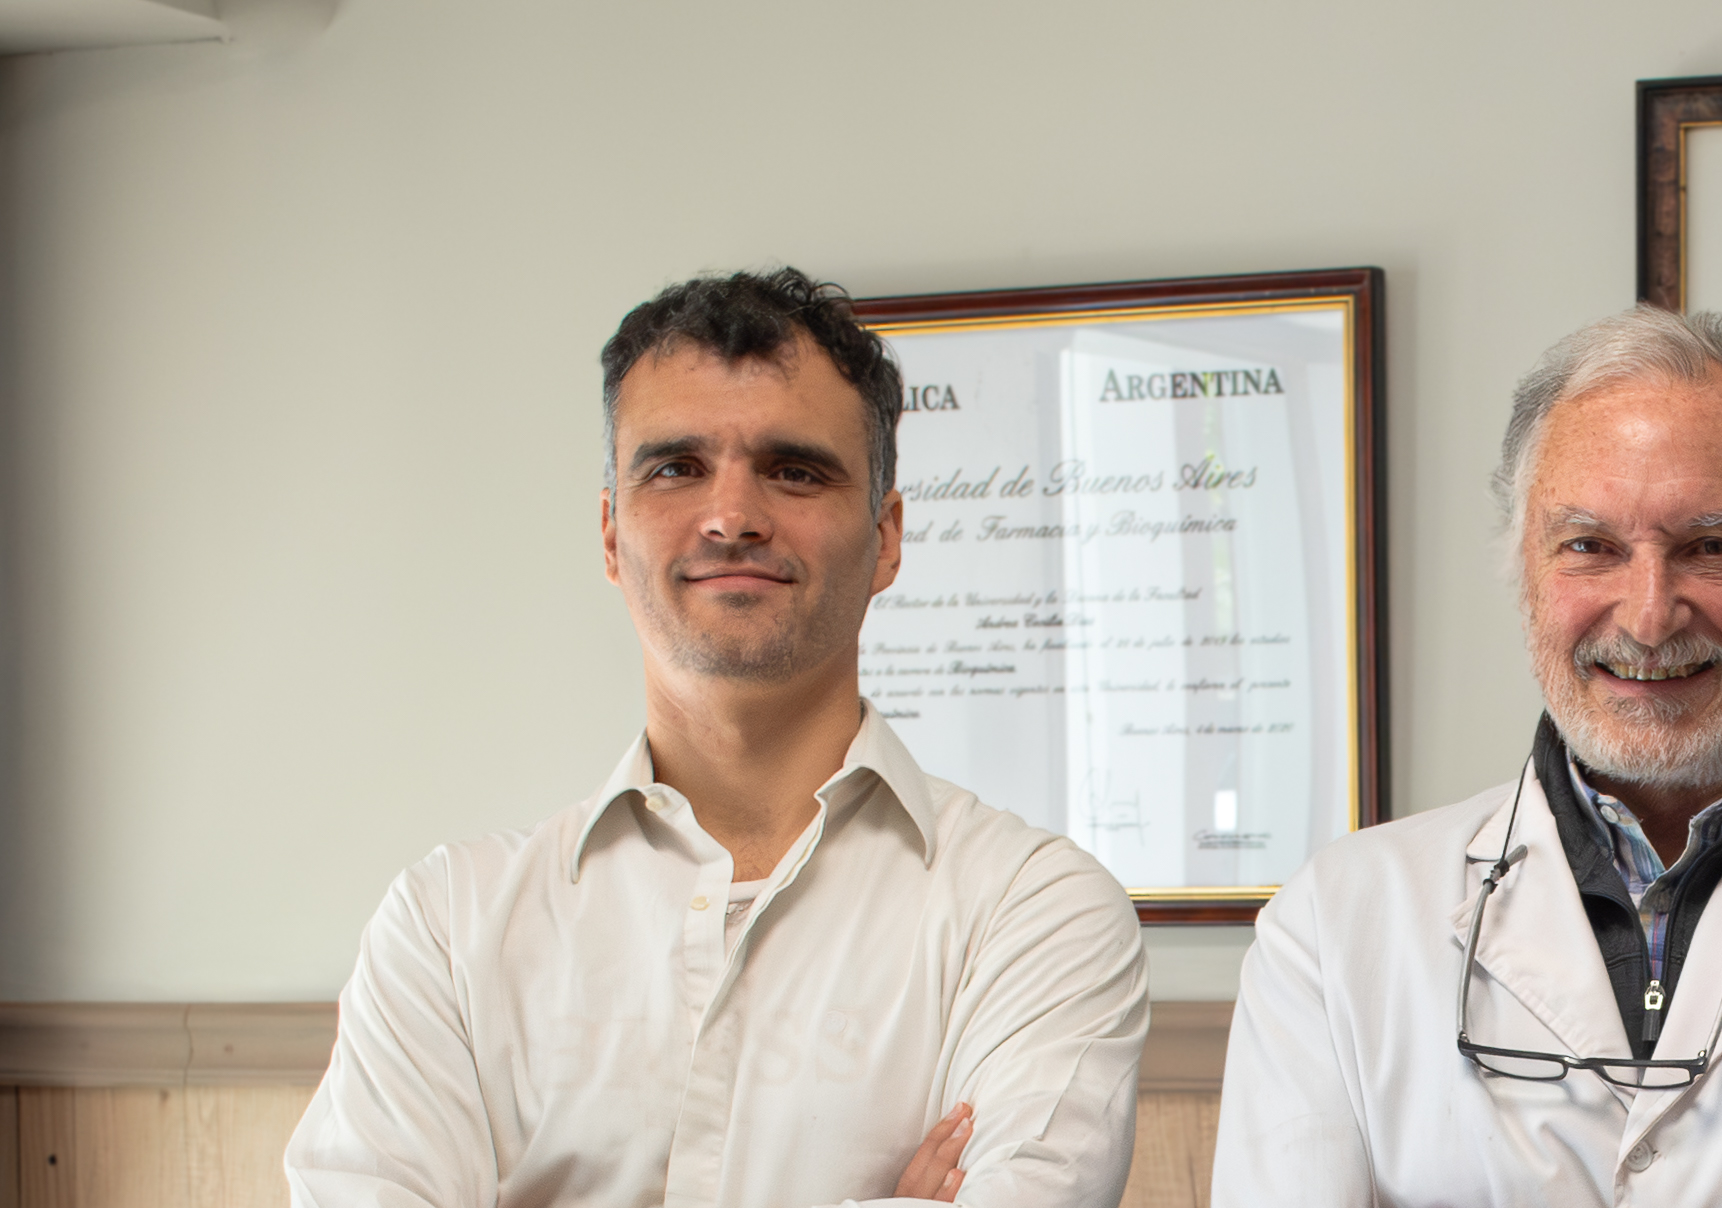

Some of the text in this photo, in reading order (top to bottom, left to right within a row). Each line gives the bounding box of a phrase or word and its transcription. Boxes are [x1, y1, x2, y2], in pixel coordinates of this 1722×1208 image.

[1099, 367, 1284, 402] ARGENTINA
[1000, 464, 1034, 499] de
[1043, 458, 1164, 498] Buenos
[1173, 453, 1258, 492] Aires
[939, 519, 963, 543] de
[976, 514, 1081, 542] Farmacia
[1104, 509, 1237, 544] Bioquímica
